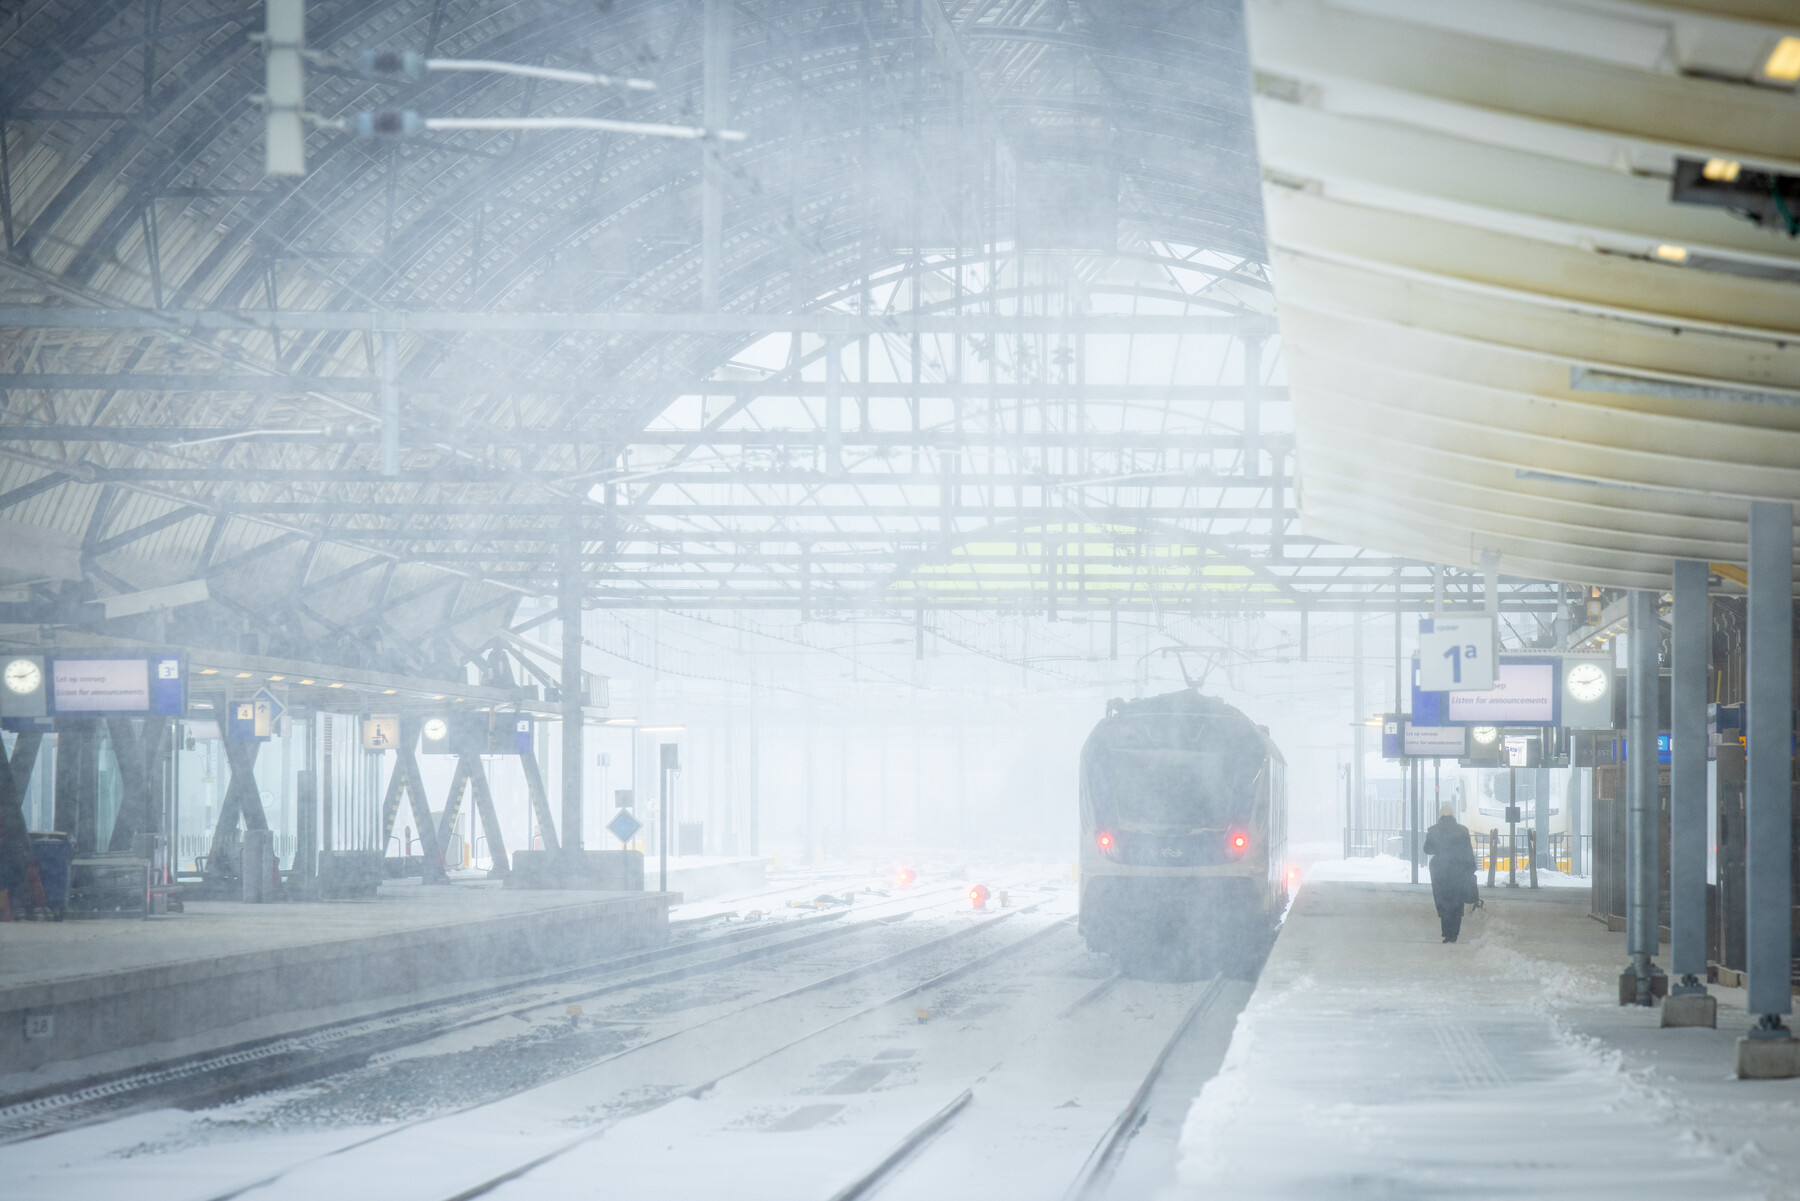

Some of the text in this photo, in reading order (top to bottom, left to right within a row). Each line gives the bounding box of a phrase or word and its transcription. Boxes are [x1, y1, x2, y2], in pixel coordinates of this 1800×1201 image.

[1436, 624, 1459, 632] spoor
[1451, 697, 1548, 705] Listen for announcements
[242, 709, 248, 718] 4
